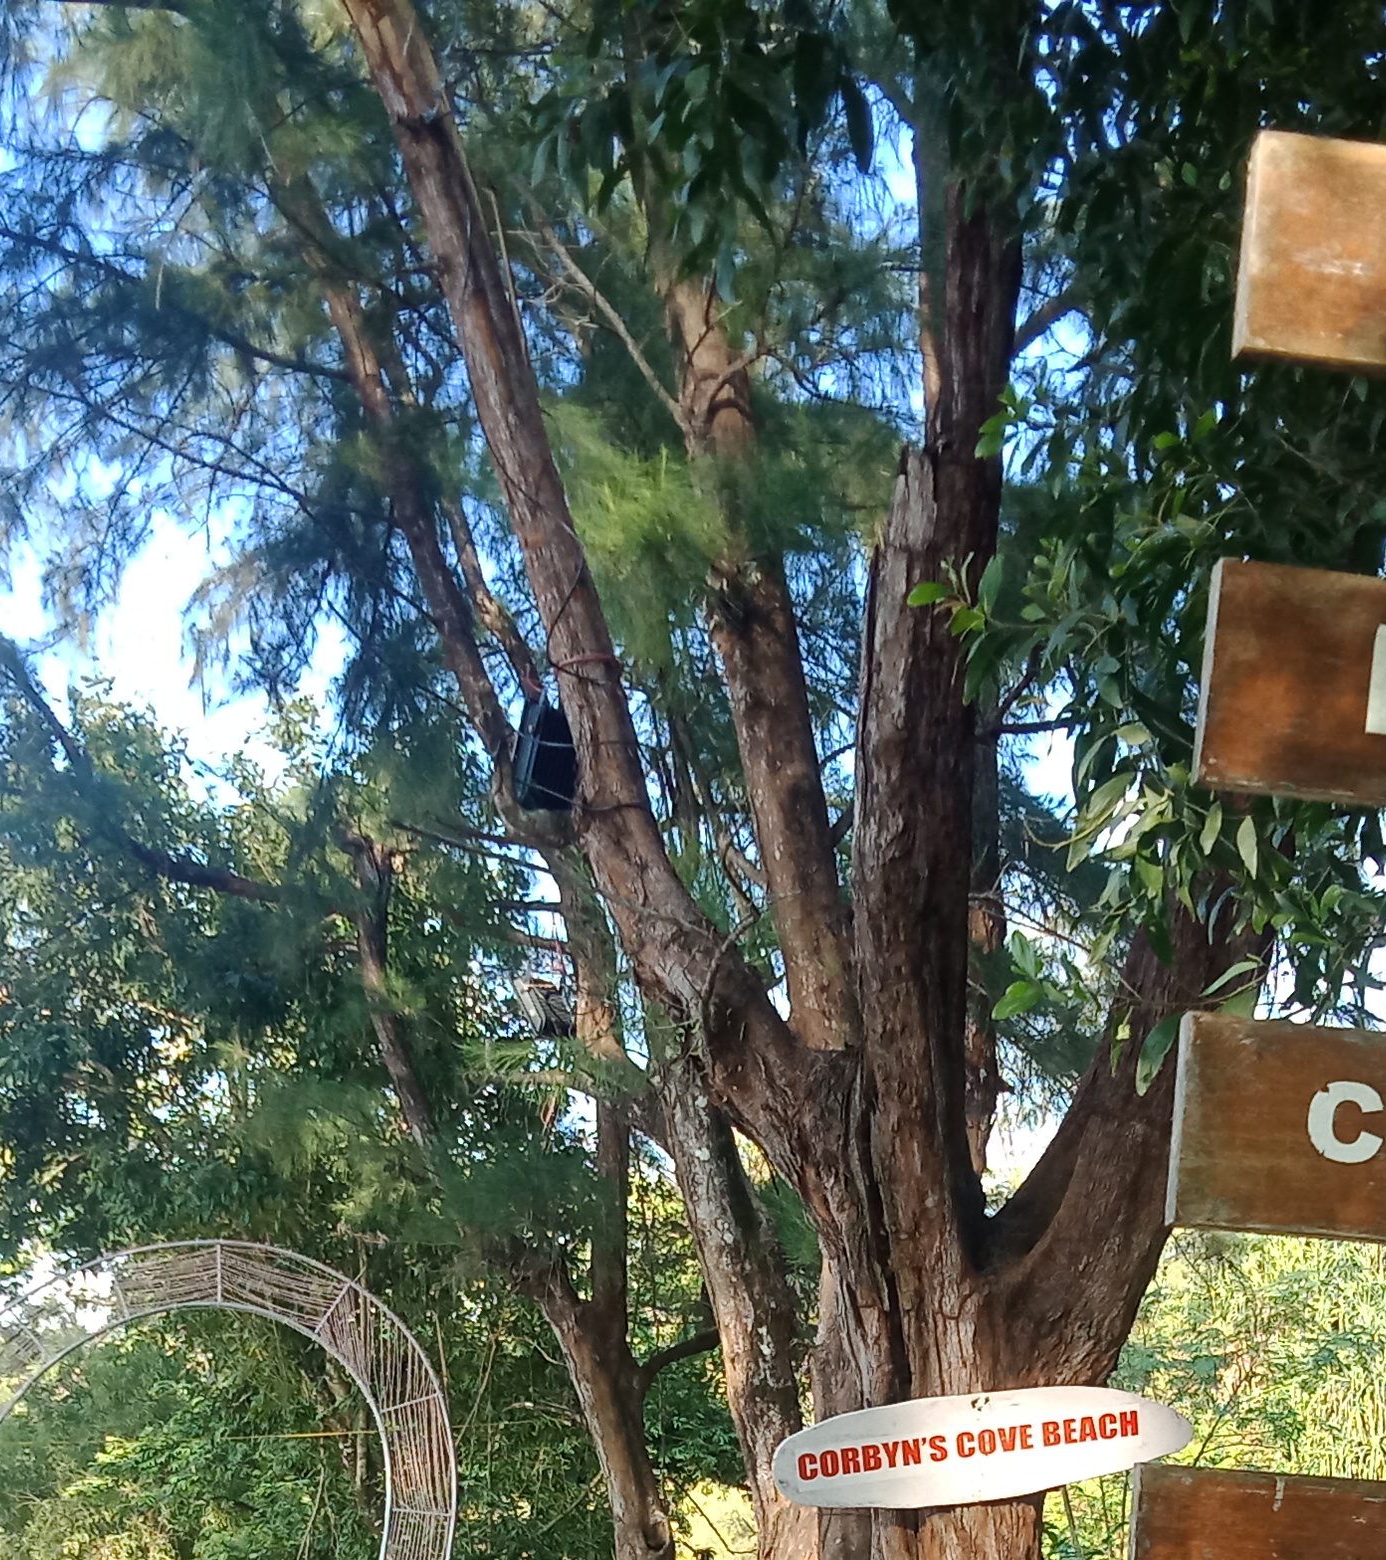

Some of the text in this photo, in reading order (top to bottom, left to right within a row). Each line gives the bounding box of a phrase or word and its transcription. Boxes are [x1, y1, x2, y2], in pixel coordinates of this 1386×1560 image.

[797, 1410, 1139, 1481] CORBYN'S COVE BEACH
